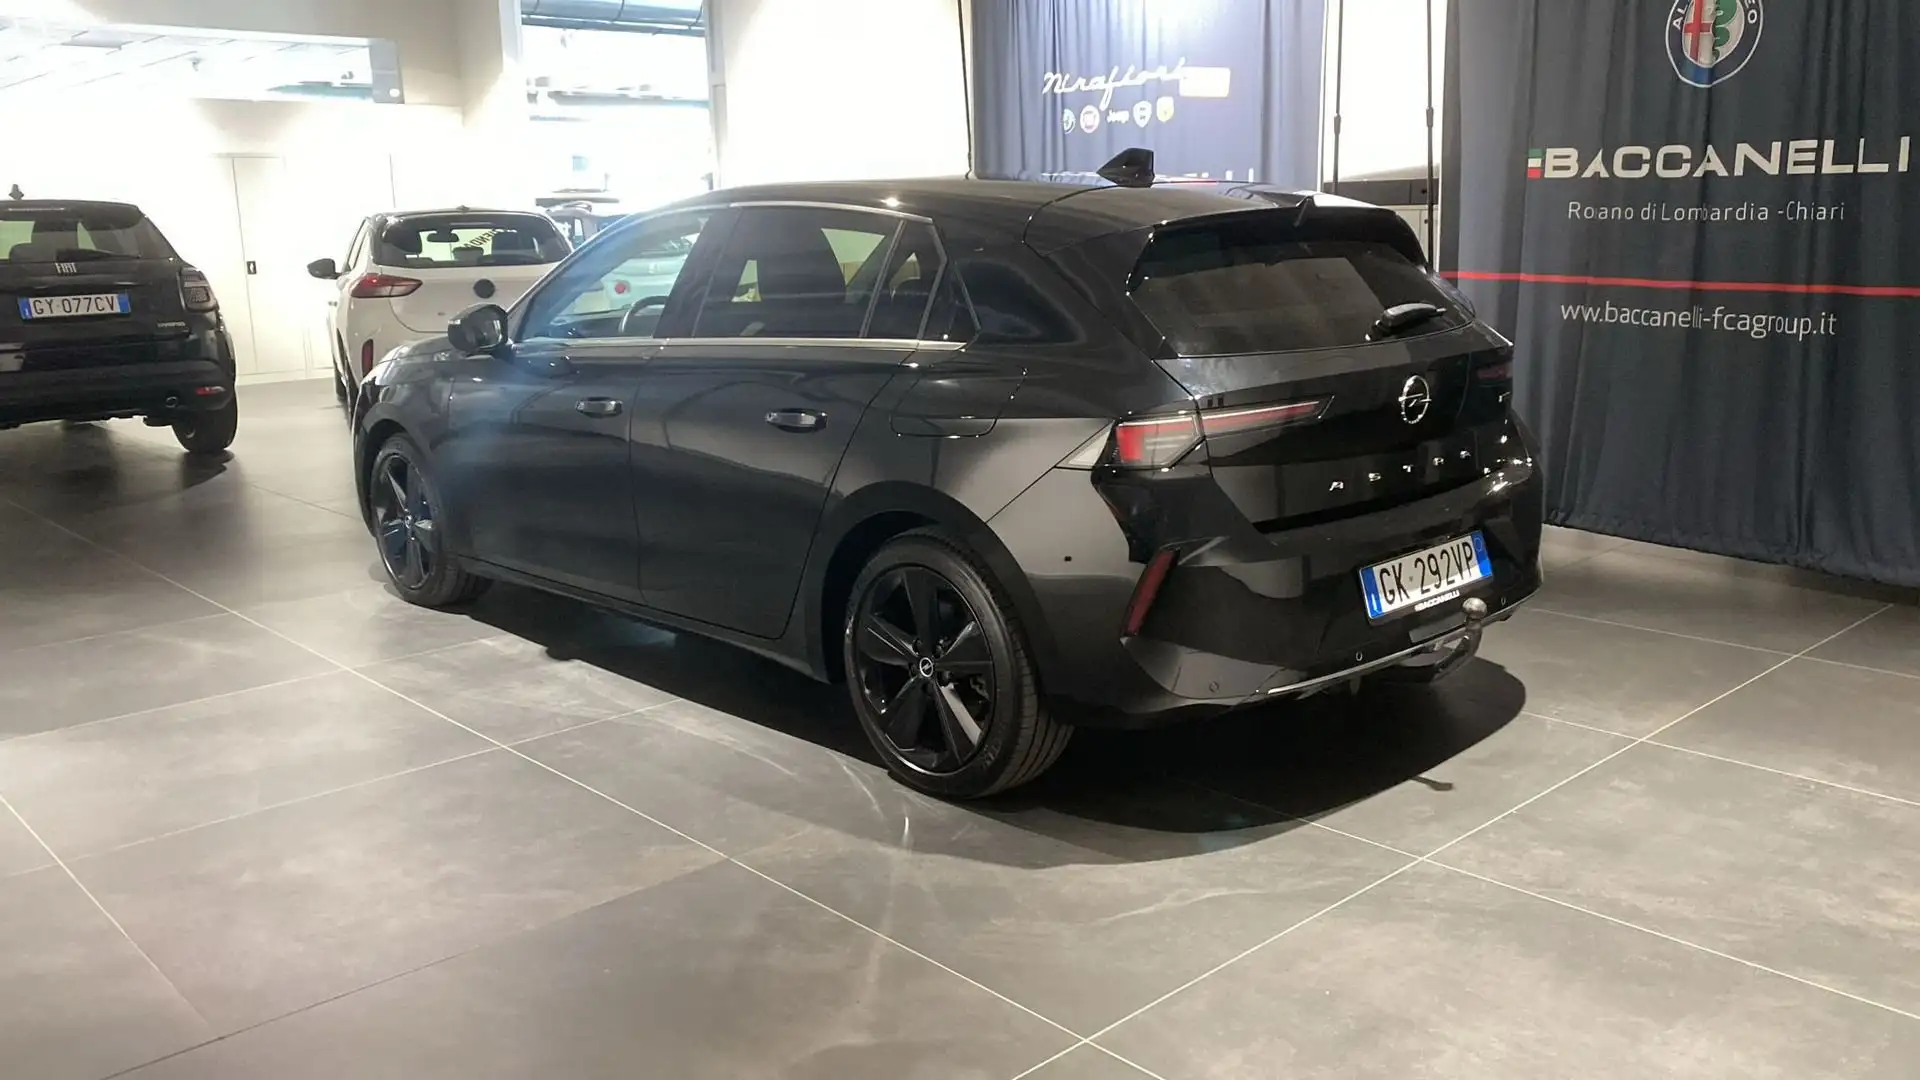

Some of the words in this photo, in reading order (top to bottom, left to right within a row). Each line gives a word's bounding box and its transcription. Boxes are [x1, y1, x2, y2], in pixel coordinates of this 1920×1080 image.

[1543, 136, 1911, 179] BACCANELLI
[1568, 201, 1634, 220] Roano
[1640, 202, 1657, 221] di
[1661, 202, 1769, 221] Lombardia
[54, 262, 77, 274] FIAT
[33, 299, 54, 315] GY
[62, 296, 115, 314] 077CV
[1379, 562, 1410, 605] GK
[1414, 541, 1474, 595] 292VP
